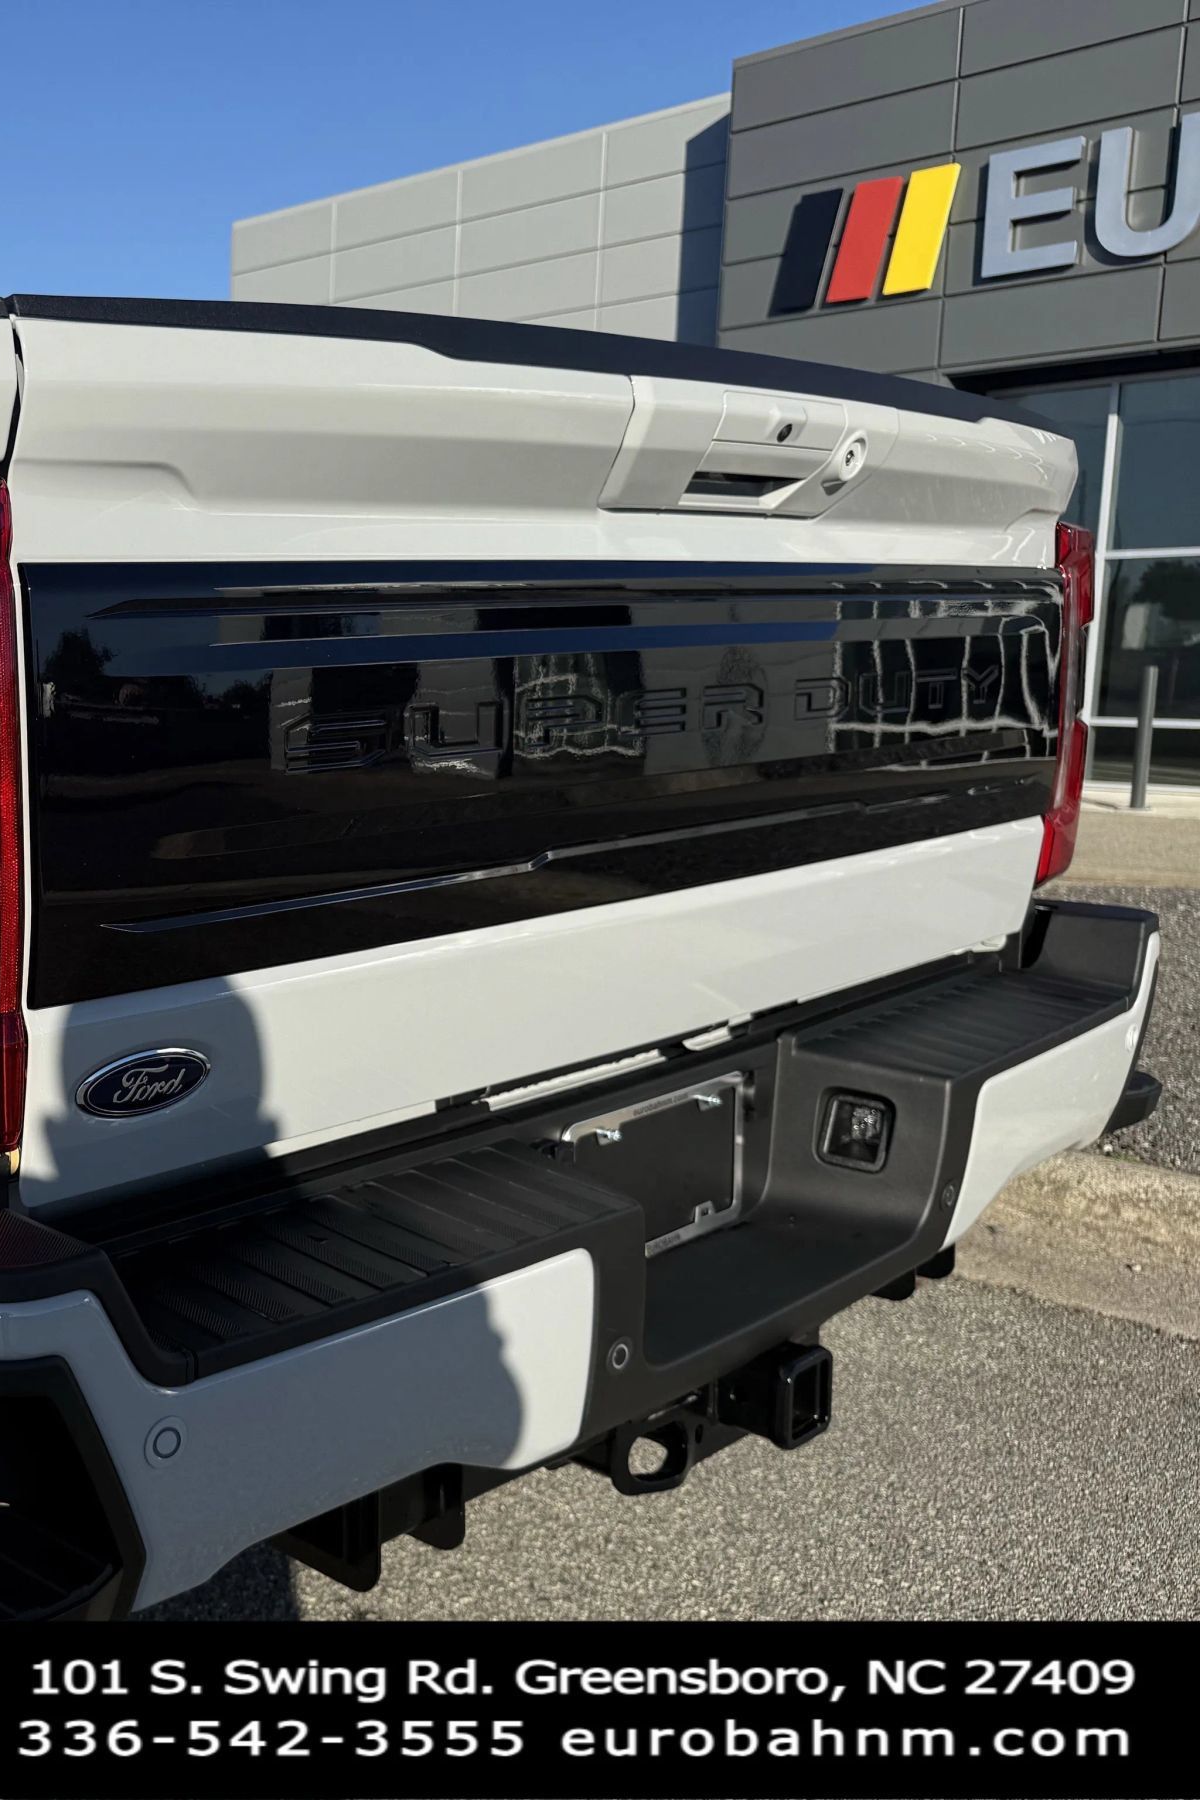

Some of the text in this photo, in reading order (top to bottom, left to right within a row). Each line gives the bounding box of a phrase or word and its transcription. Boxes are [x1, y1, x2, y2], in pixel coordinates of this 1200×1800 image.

[981, 110, 1200, 279] EU
[281, 664, 999, 775] SUPER DUTY
[113, 1064, 186, 1103] Ford
